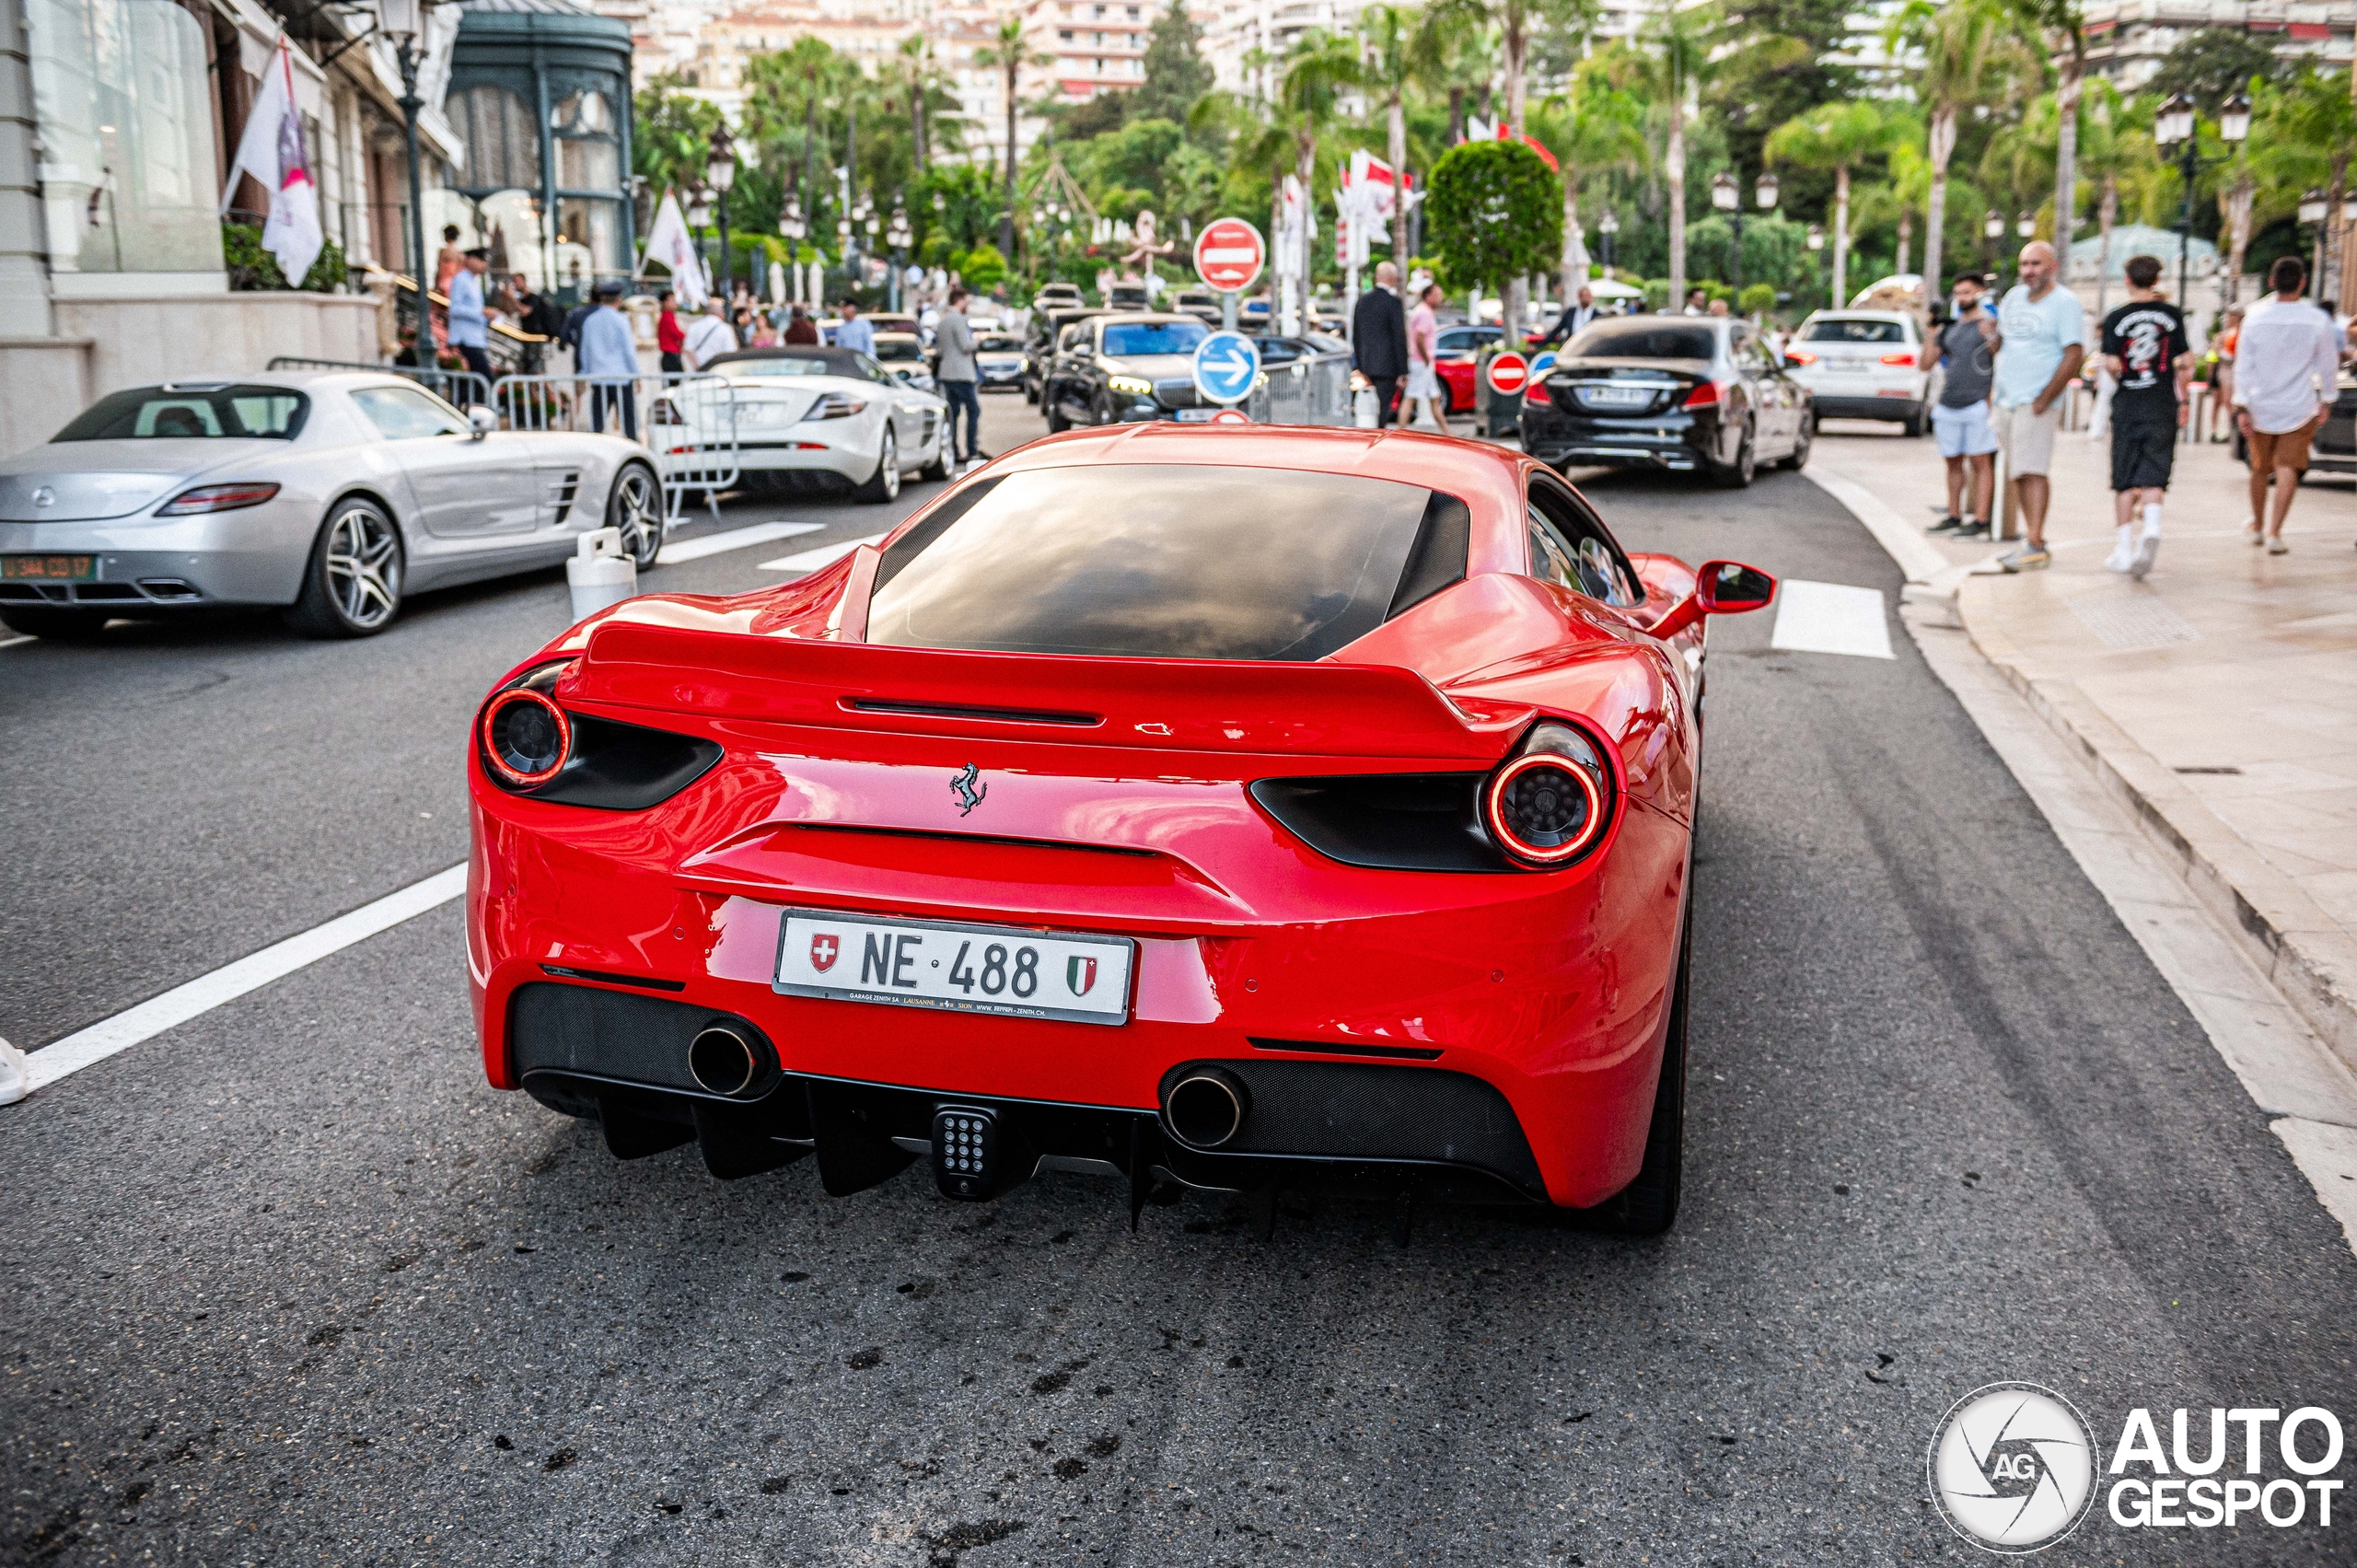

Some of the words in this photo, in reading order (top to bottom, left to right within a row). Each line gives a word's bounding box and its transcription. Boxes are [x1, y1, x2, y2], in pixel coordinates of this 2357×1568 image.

[861, 932, 922, 988] NE
[948, 940, 1039, 998] 488
[849, 993, 873, 1001] GARAGE
[903, 997, 935, 1006] LAUSANNE
